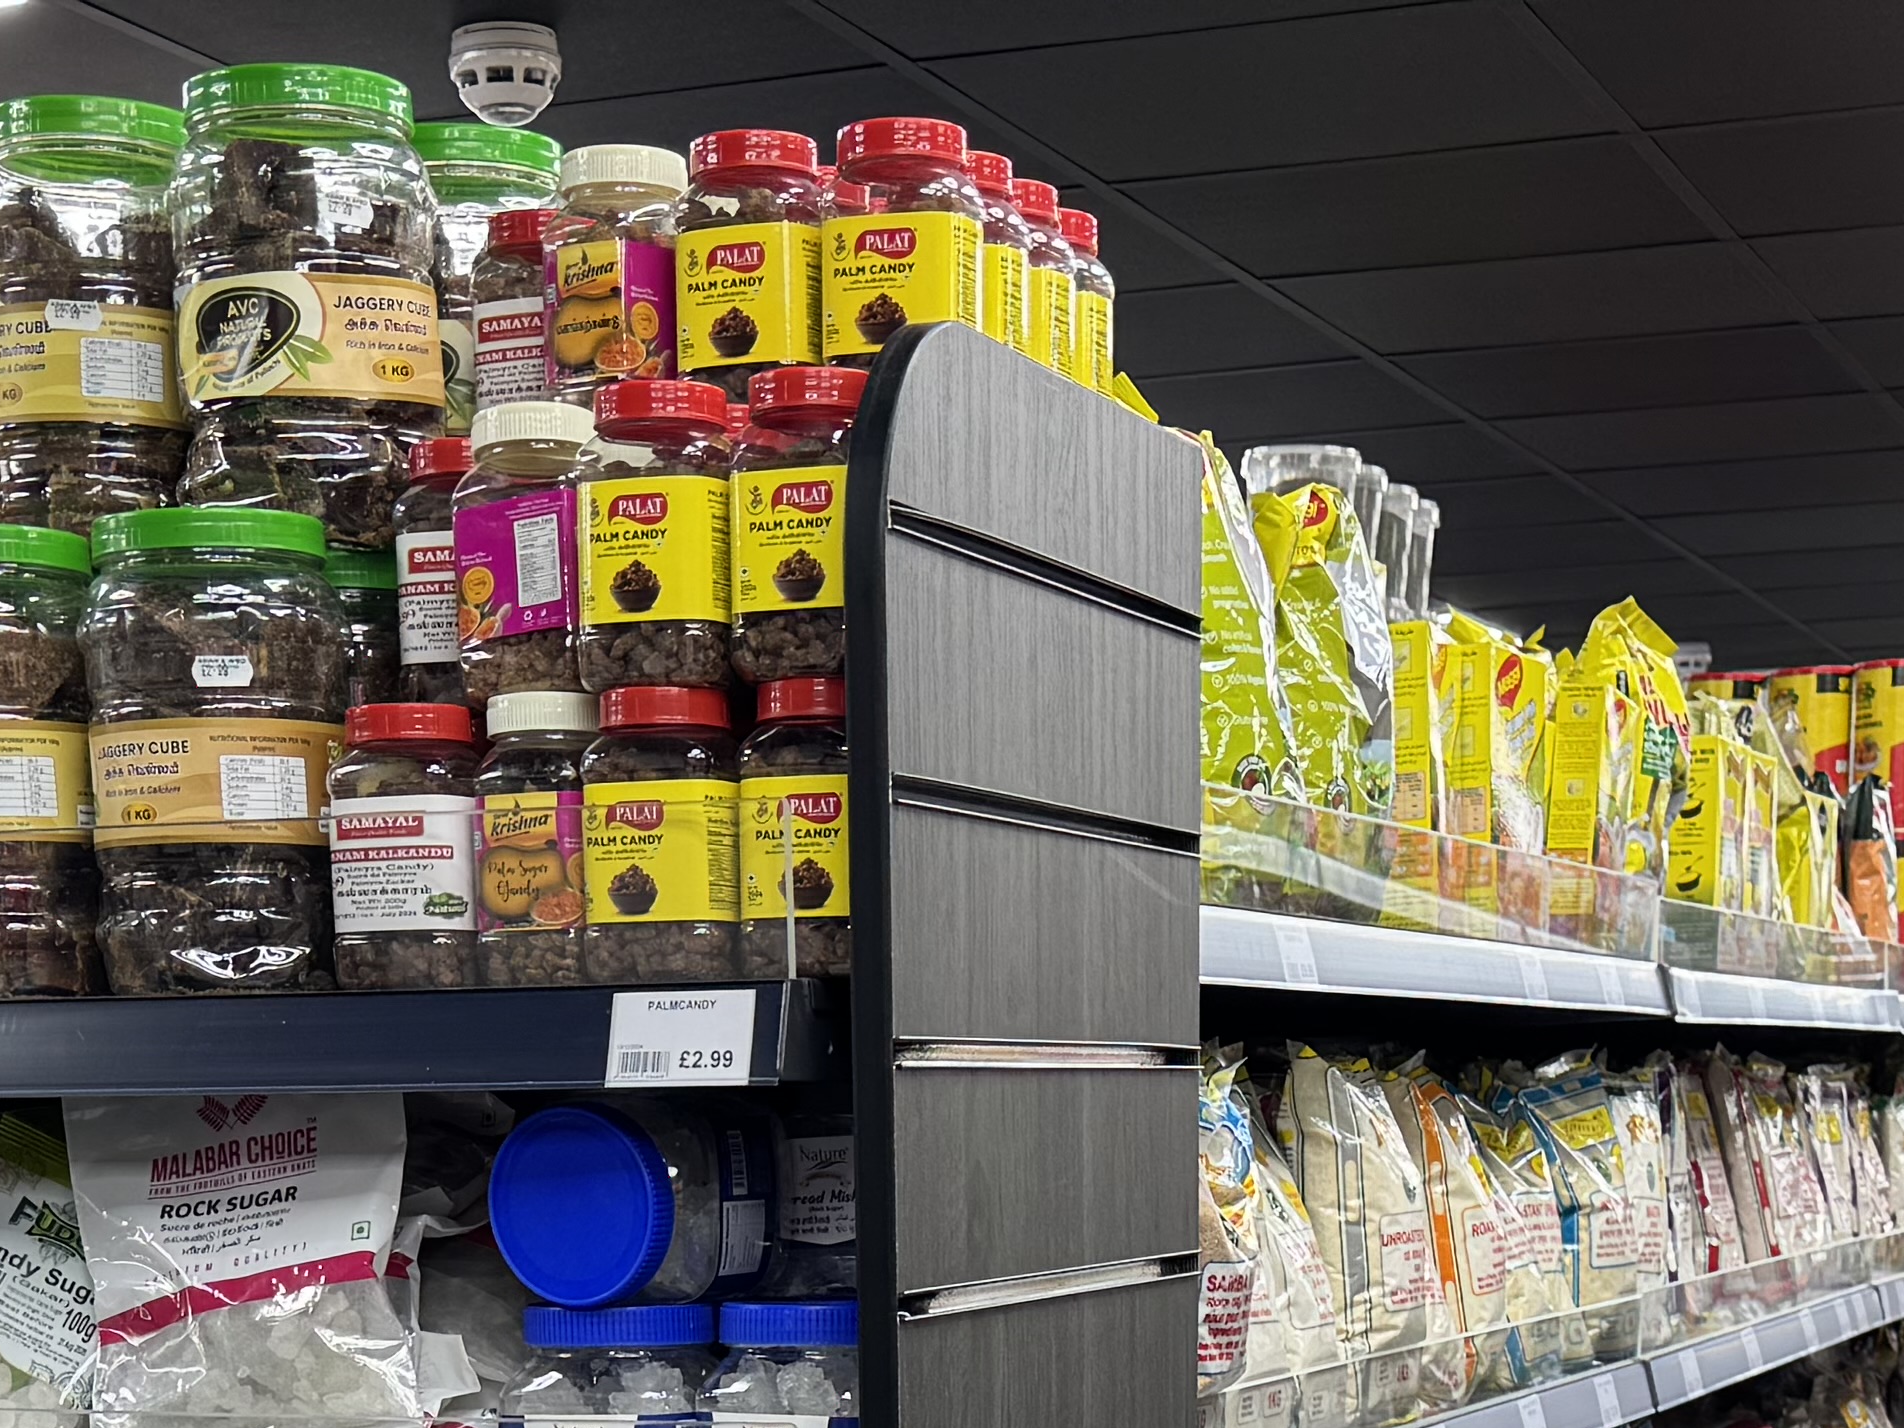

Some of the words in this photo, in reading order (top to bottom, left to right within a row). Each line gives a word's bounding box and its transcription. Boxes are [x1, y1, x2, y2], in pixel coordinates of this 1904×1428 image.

[865, 233, 913, 253] PALAT
[716, 248, 760, 266] PALAT
[833, 266, 865, 279] PALM
[869, 262, 915, 276] CANDY
[687, 278, 717, 294] PALM
[721, 275, 765, 291] CANDY
[228, 299, 259, 317] AVC
[333, 296, 403, 313] JAGGERY
[407, 303, 432, 318] CUBE
[782, 487, 827, 506] PALAT
[618, 497, 665, 519] PALAT
[749, 520, 785, 533] PALM
[790, 516, 832, 530] CANDY
[615, 802, 662, 823] PALAT
[789, 795, 837, 815] PALAT
[341, 816, 418, 830] SAMAYAL
[587, 836, 617, 848] PALM
[619, 833, 664, 847] CANDY
[648, 1000, 717, 1011] PALMCANDY
[679, 1050, 733, 1069] £2.99
[151, 1140, 241, 1183] MALABAR
[247, 1126, 318, 1160] CHOICE
[160, 1199, 220, 1220] ROCK
[224, 1186, 298, 1213] SUGAR
[191, 1221, 203, 1231] de
[62, 1308, 97, 1343] 100g
